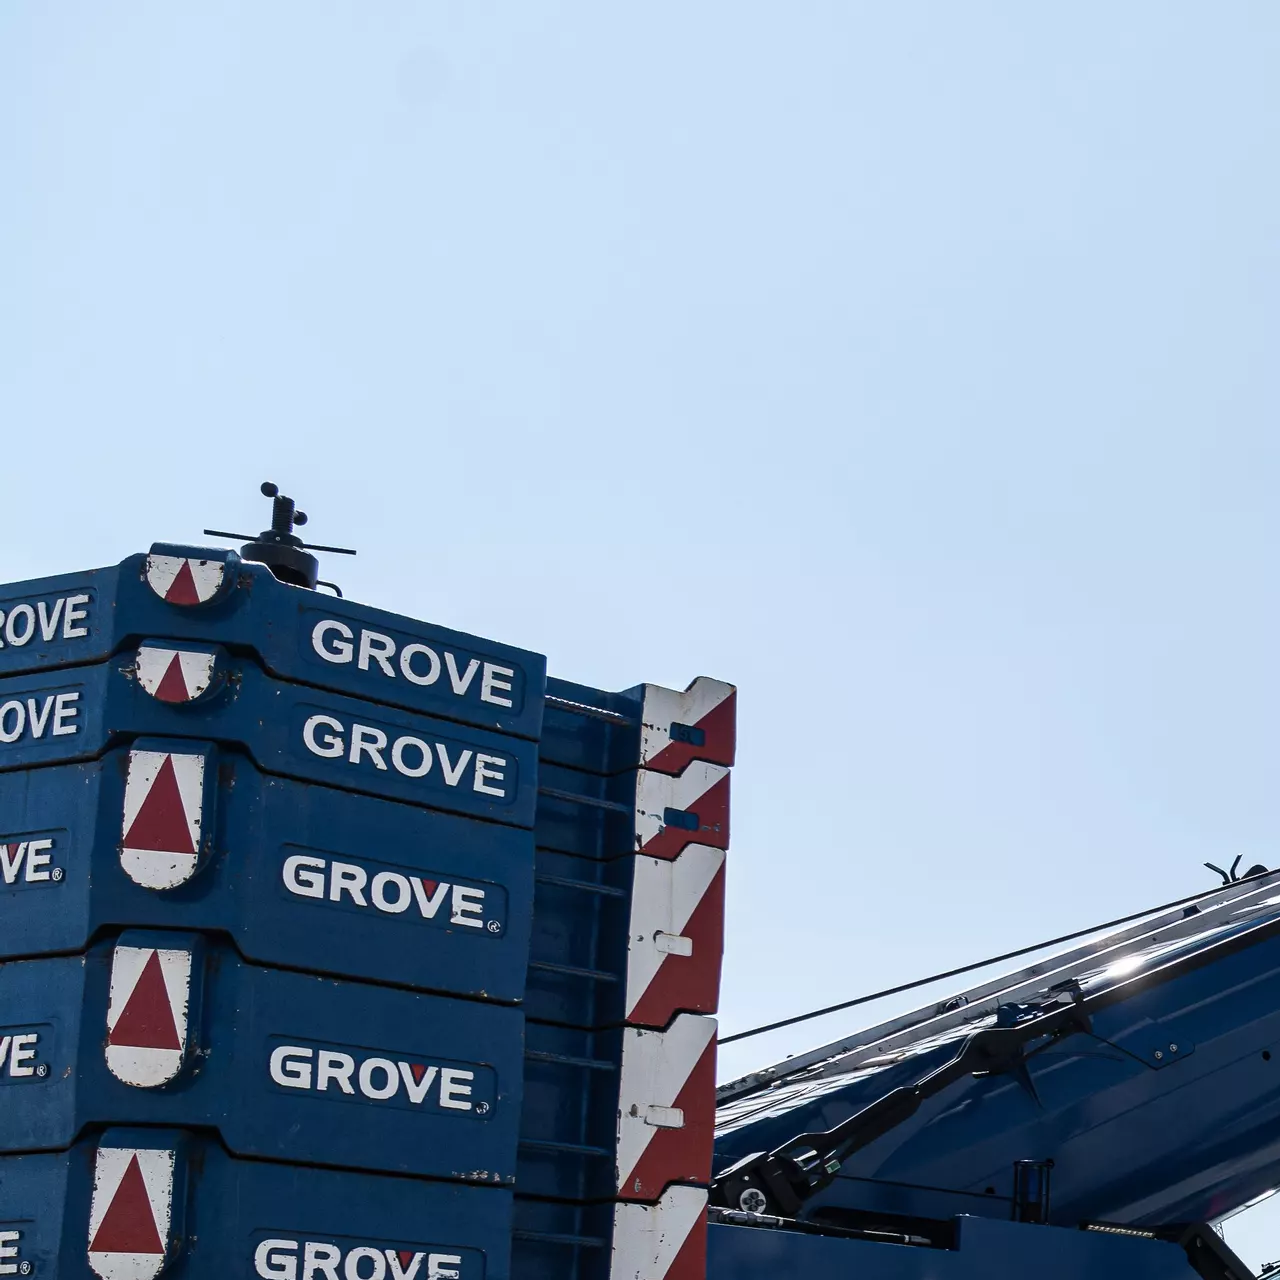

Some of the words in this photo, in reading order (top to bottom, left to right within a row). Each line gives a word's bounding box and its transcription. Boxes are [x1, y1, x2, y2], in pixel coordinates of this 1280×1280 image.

[311, 619, 514, 708] GROVE
[303, 714, 506, 798] GROVE
[282, 855, 485, 928] GROVE
[269, 1045, 474, 1110] GROVE
